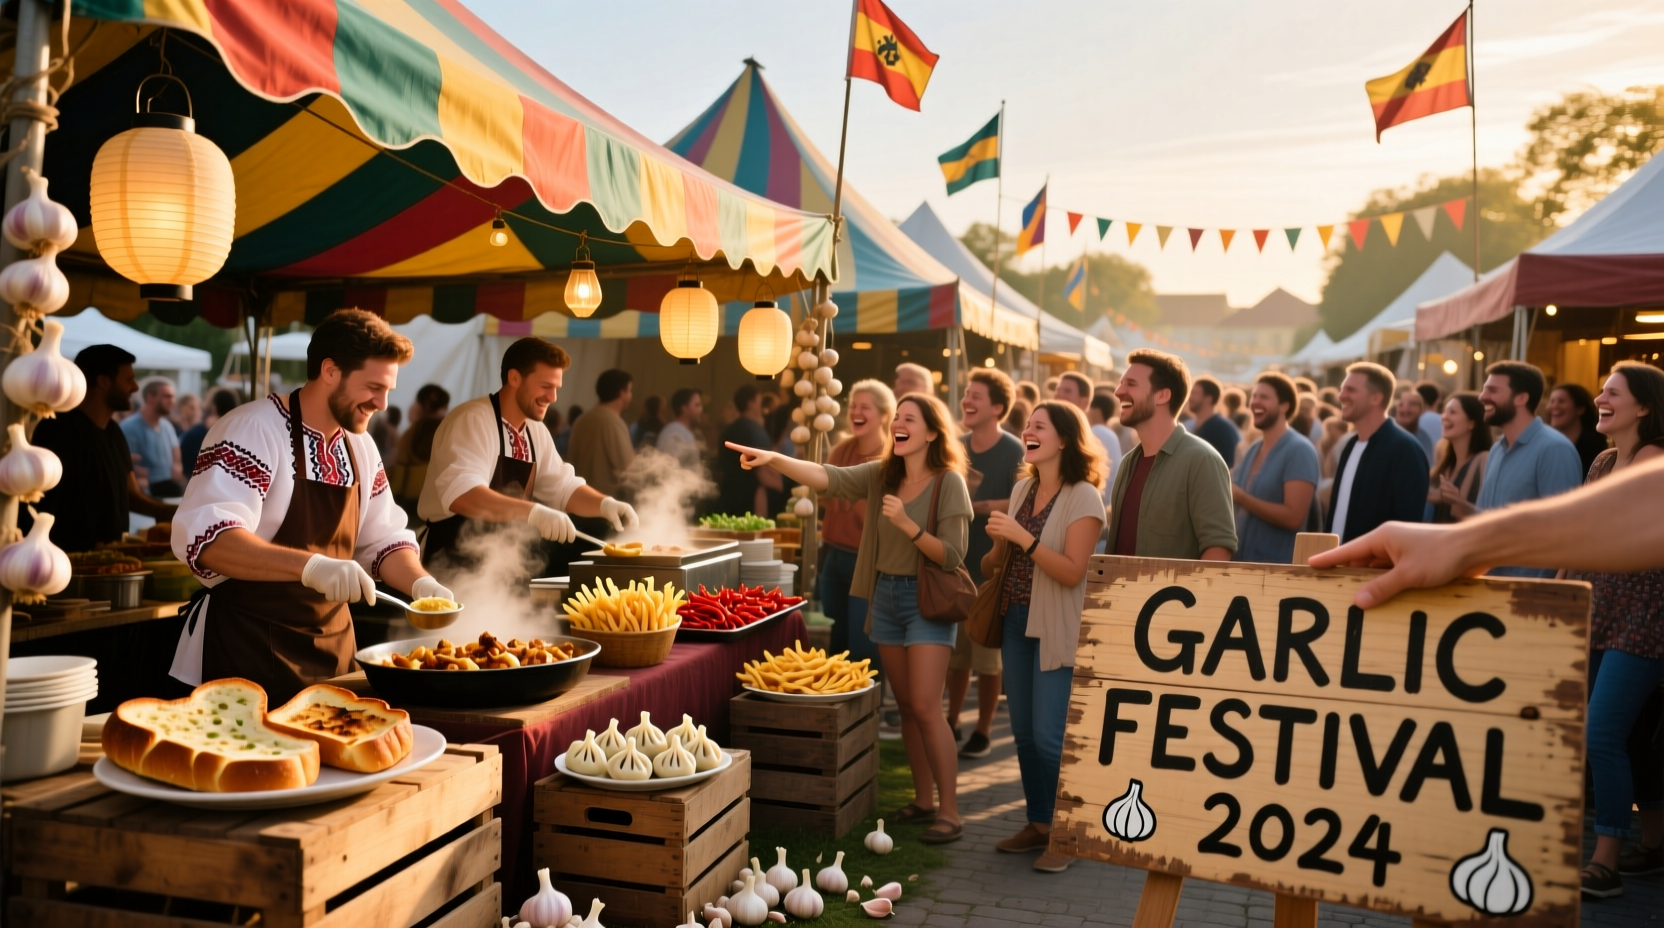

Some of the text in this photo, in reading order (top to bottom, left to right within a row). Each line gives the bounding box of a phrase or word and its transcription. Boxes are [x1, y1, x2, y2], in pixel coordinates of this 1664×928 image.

[1134, 585, 1507, 703] GARLIC
[1098, 688, 1545, 822] FESTIVAL
[1197, 792, 1401, 887] 2024
